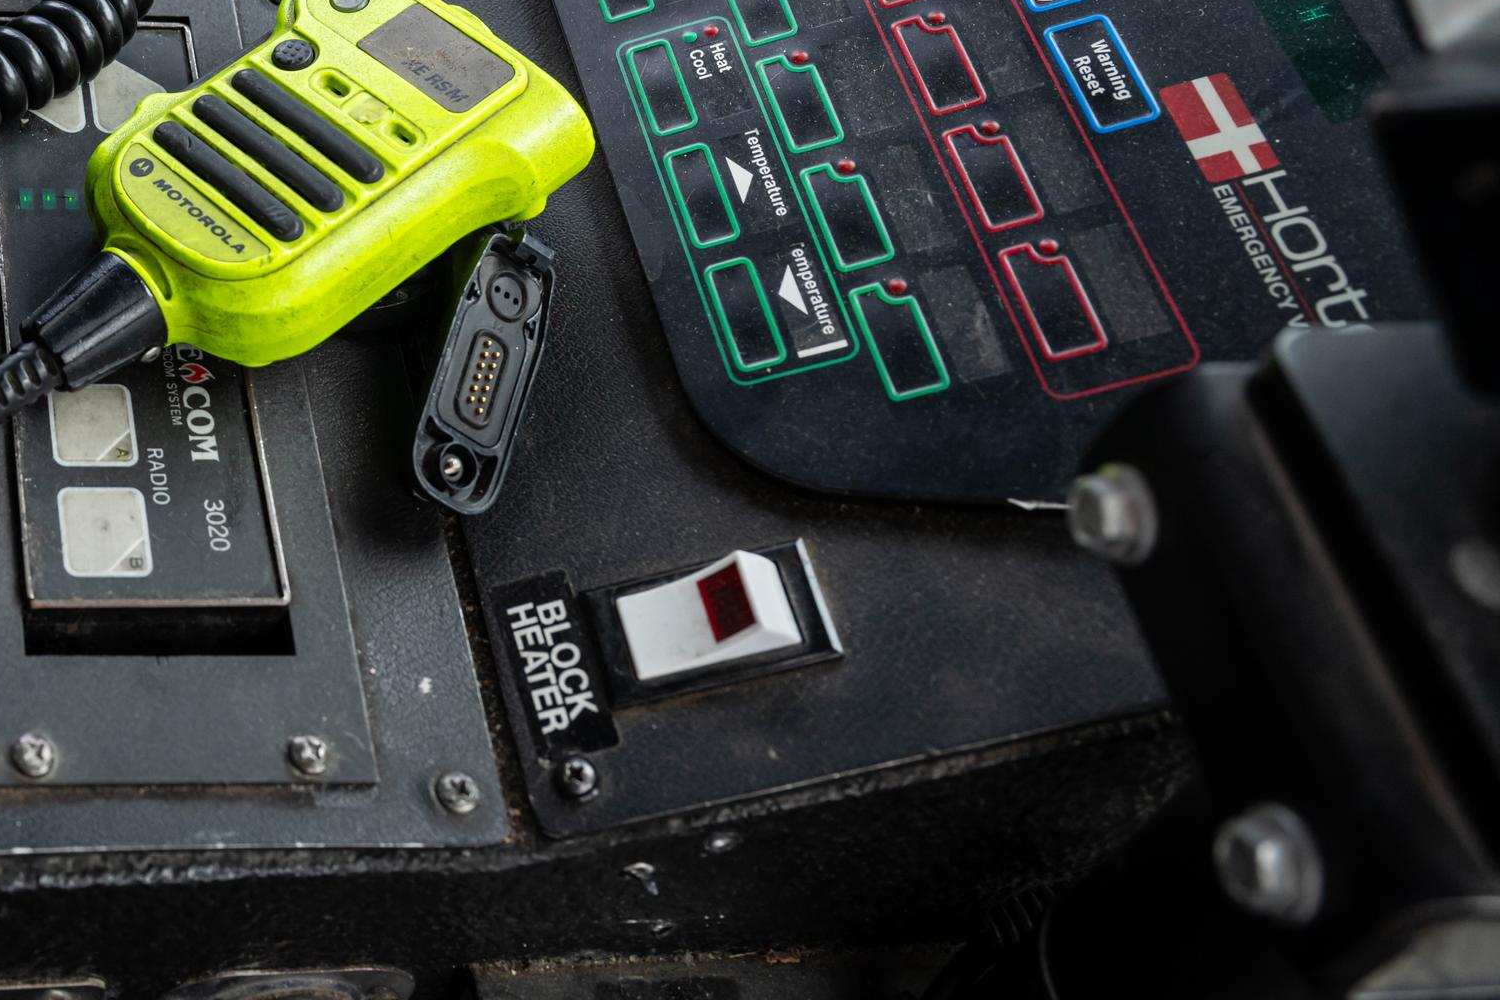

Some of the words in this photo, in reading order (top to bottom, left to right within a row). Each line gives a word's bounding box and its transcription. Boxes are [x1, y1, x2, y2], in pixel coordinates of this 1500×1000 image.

[689, 49, 712, 80] Cool
[709, 42, 732, 74] Heat
[1073, 55, 1105, 97] Reset
[1089, 38, 1132, 101] Warning
[423, 68, 469, 107] RSM
[744, 127, 788, 217] Temperature
[152, 177, 247, 256] MOTOROLA
[1212, 184, 1300, 309] EMERGENCY
[790, 241, 836, 336] emperature
[165, 383, 182, 427] SYSTEM
[146, 447, 171, 505] RADIO
[204, 499, 231, 552] 3020
[129, 556, 144, 571] B
[506, 602, 570, 736] HEATER
[537, 600, 598, 721] BLOCK
